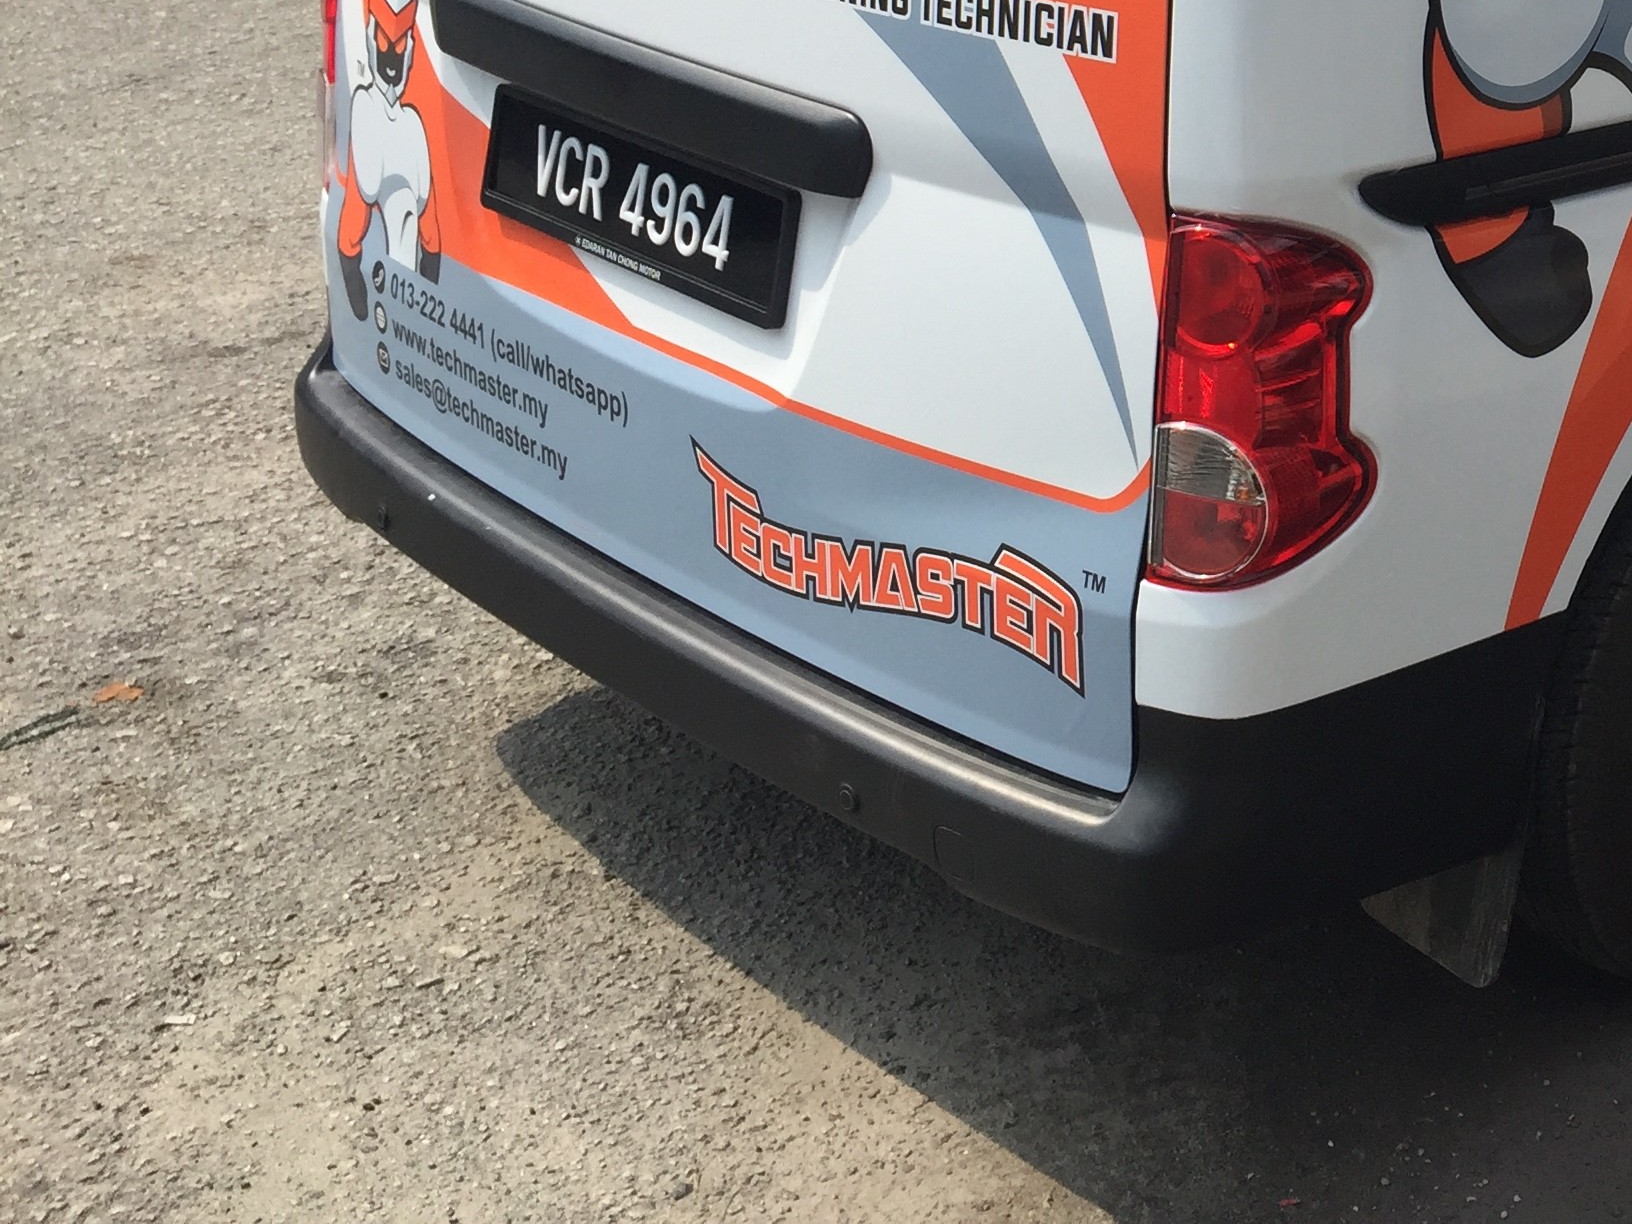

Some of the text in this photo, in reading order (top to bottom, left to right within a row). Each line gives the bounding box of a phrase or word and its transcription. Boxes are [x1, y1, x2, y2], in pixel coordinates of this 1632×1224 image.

[536, 123, 735, 272] VCR 4964
[581, 238, 661, 281] EDARAN TAN CHONG MOTOR
[389, 272, 629, 429] 013-222 4441 (call/whatsapp)
[392, 318, 549, 429] www.techmaster.my
[395, 357, 568, 481] sales@techmaster.my
[690, 433, 1086, 698] TECHMASTER
